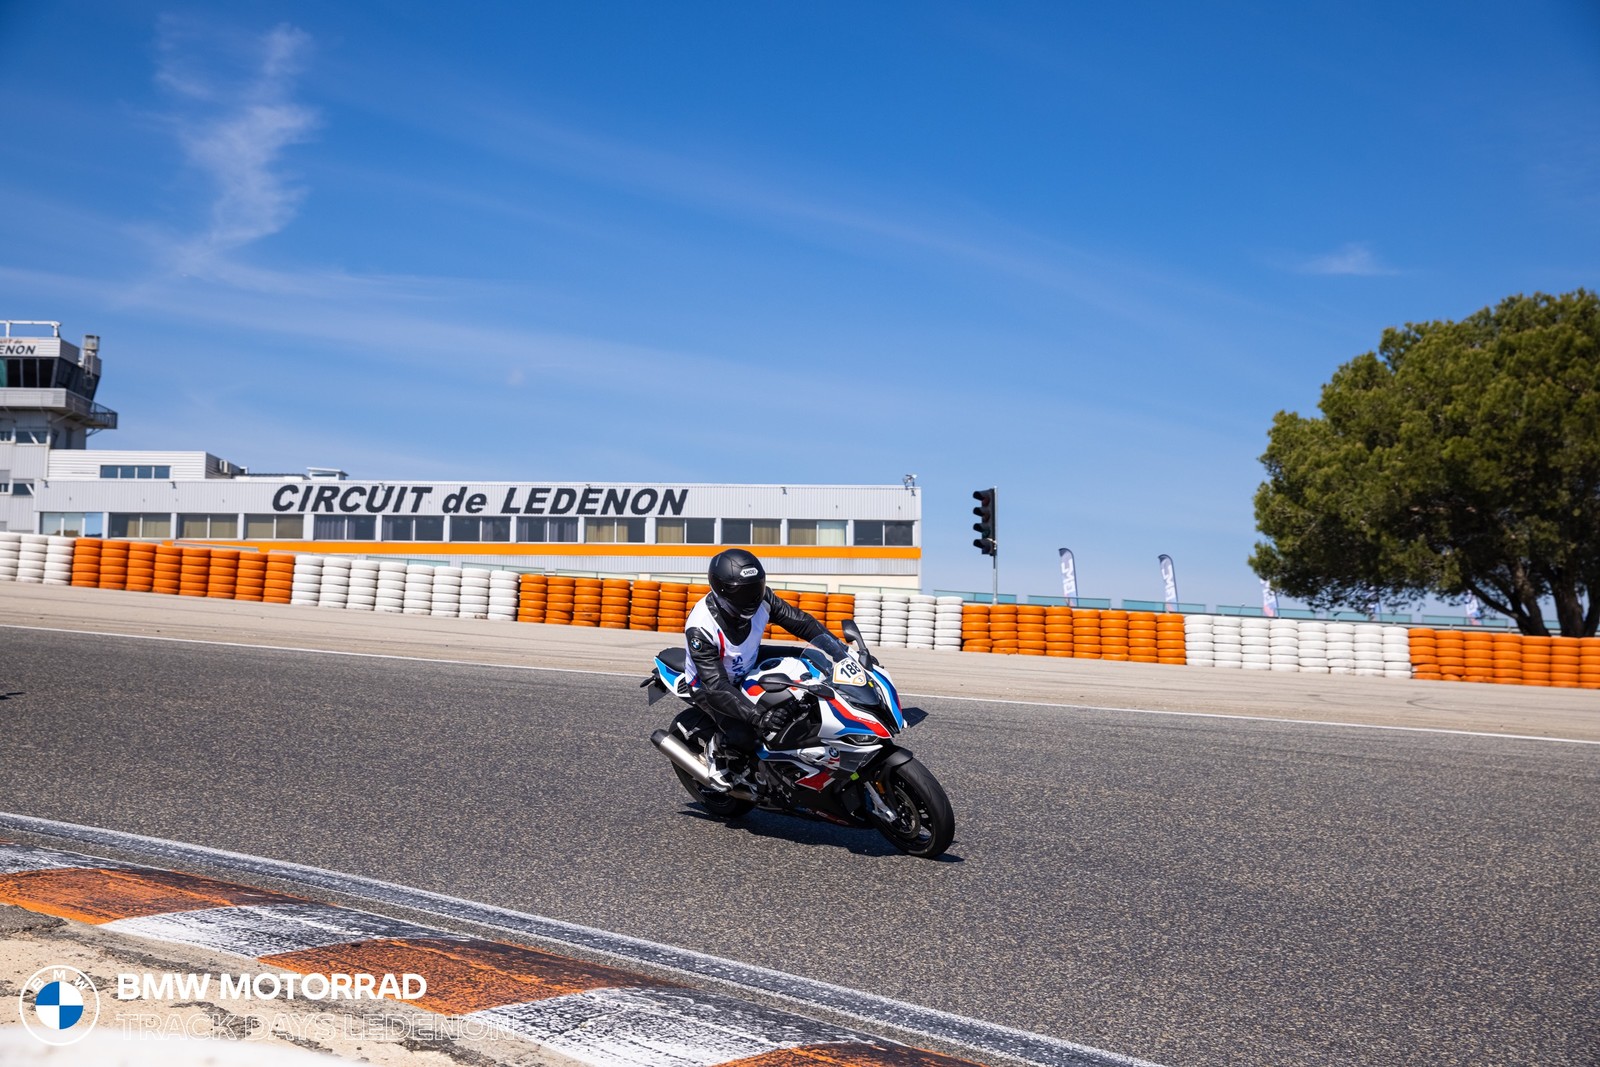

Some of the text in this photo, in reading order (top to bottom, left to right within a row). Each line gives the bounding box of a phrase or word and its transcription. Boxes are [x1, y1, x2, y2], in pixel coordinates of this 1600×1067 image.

[272, 484, 689, 516] CIRCUIT de LEDENON
[840, 661, 861, 679] 188
